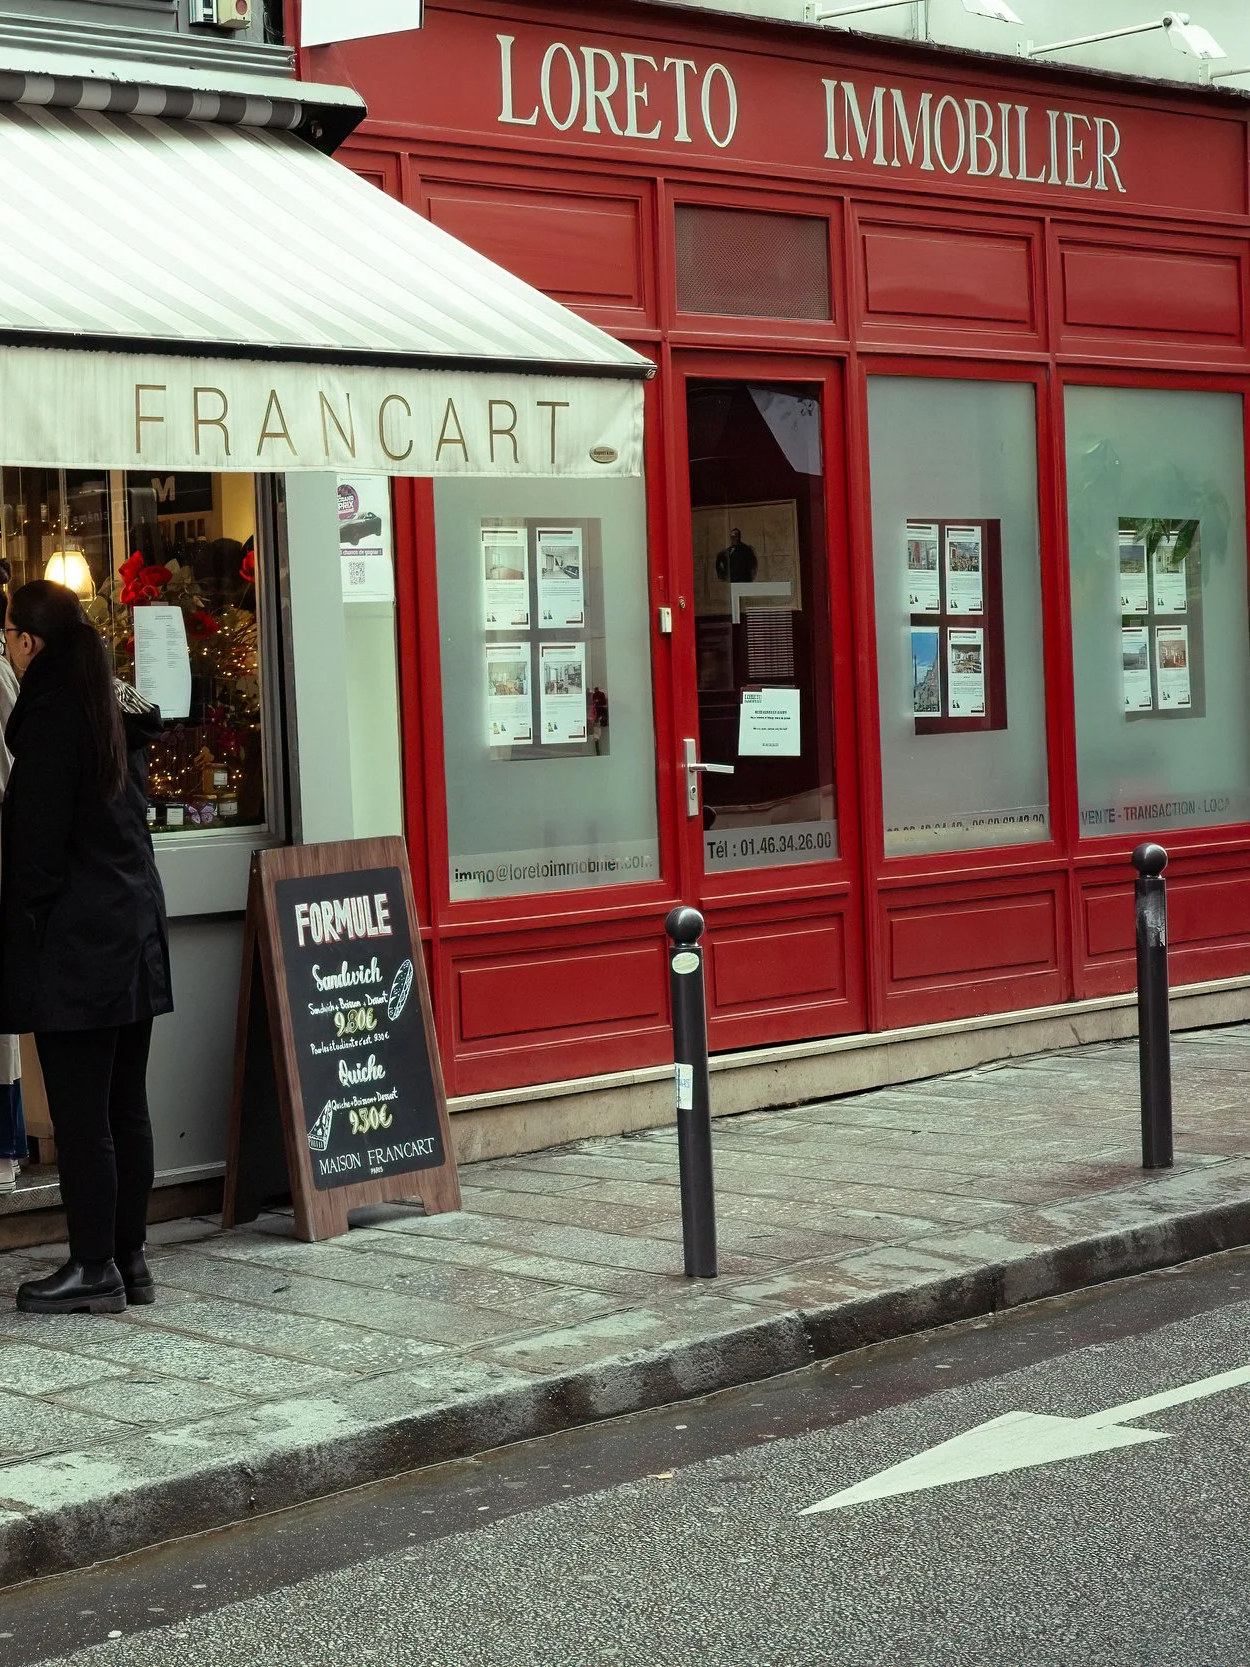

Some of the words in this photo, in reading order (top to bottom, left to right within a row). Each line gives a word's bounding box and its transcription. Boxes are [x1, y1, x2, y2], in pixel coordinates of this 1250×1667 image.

[495, 33, 738, 148] LORETO
[821, 78, 1126, 194] IMMOBILIER
[134, 383, 570, 465] FRANCART
[1081, 808, 1116, 826] VENTE
[1123, 800, 1196, 822] TRANSACTION
[707, 840, 728, 860] Tél
[740, 832, 832, 857] 01.46.34.26.00
[294, 892, 393, 947] FORMULE
[312, 956, 383, 993] Sandwich
[338, 1053, 386, 1088] Quiche
[319, 1152, 362, 1176] MAISON
[367, 1137, 435, 1166] FRANCART
